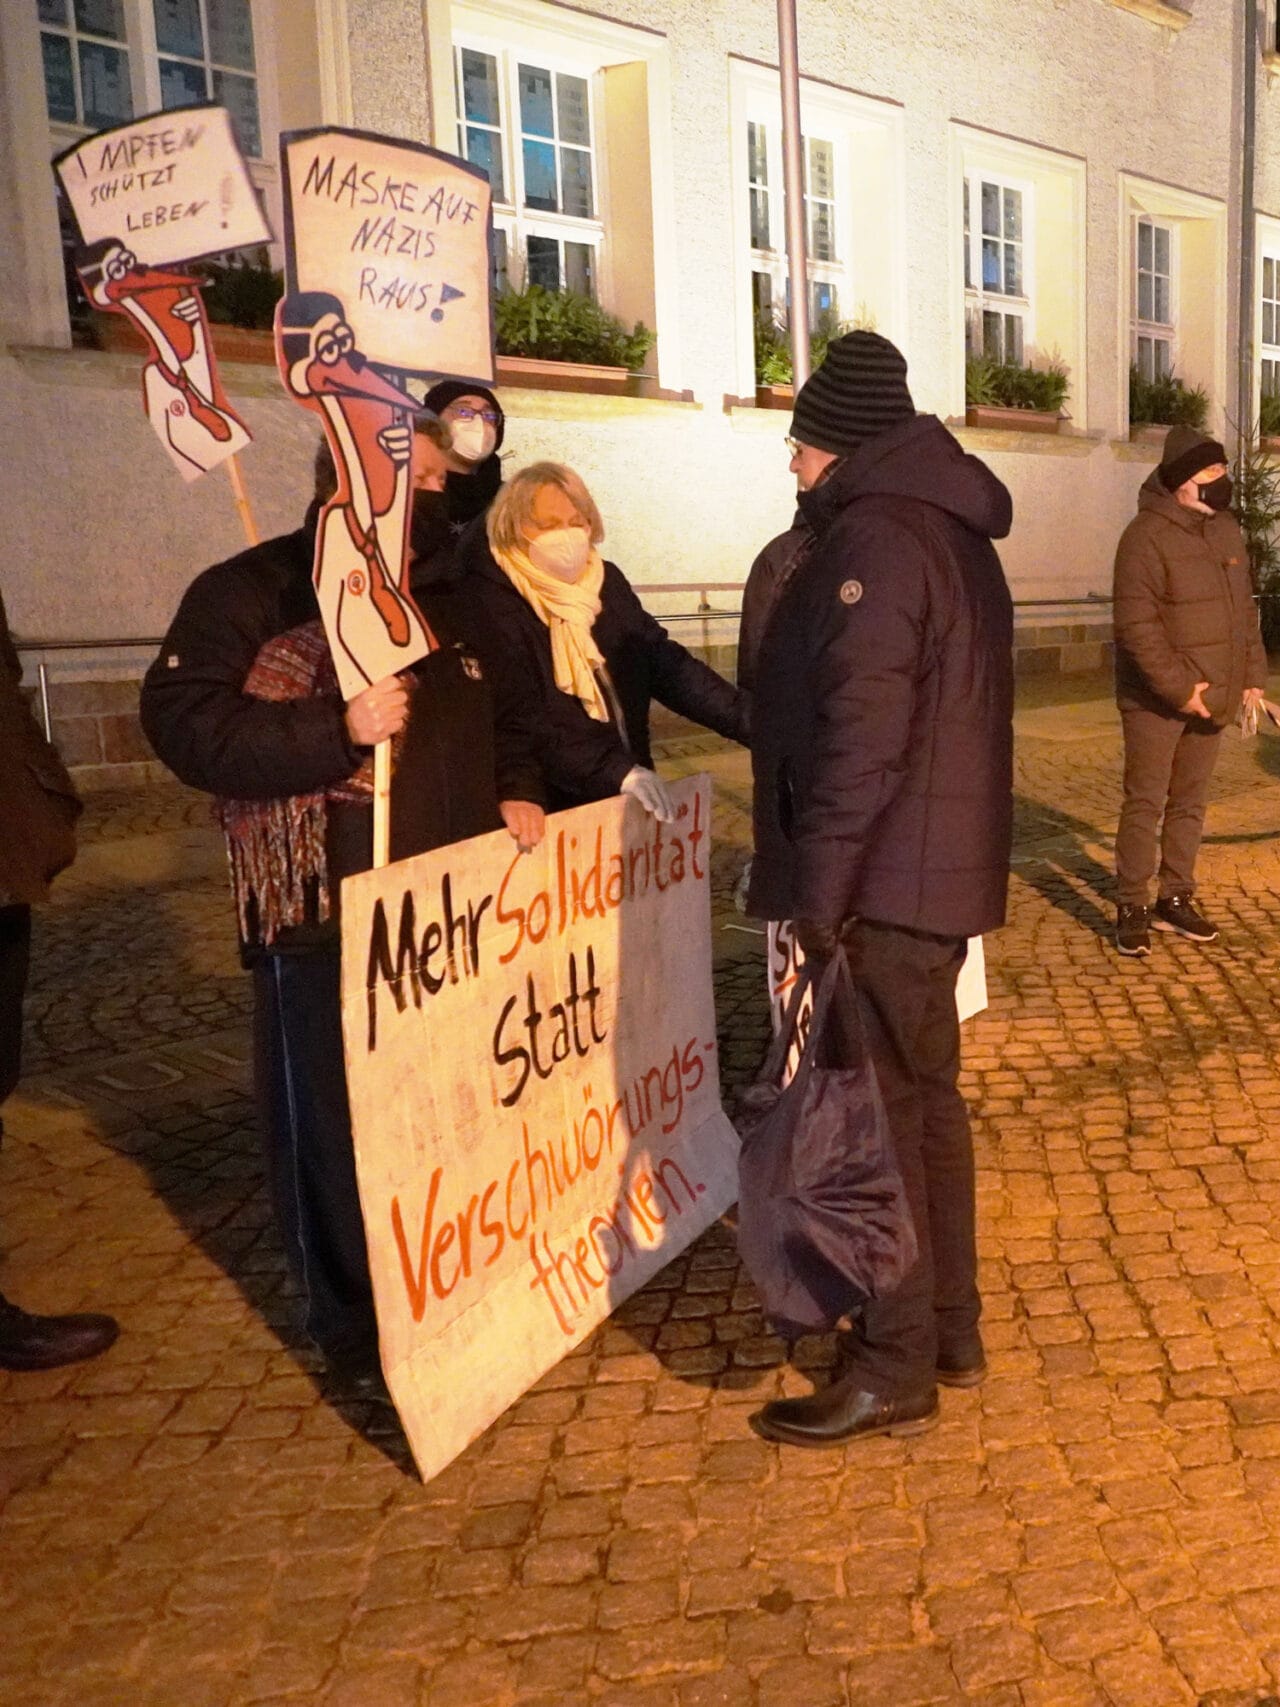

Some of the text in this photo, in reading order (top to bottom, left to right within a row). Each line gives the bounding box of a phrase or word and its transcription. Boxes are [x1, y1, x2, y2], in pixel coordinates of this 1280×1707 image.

[90, 163, 177, 207] SCHÜTZT
[302, 155, 480, 225] MASKE AUF
[351, 216, 437, 260] NAZIS
[366, 791, 704, 1052] Mehr Solidarität
[493, 944, 607, 1108] Statt
